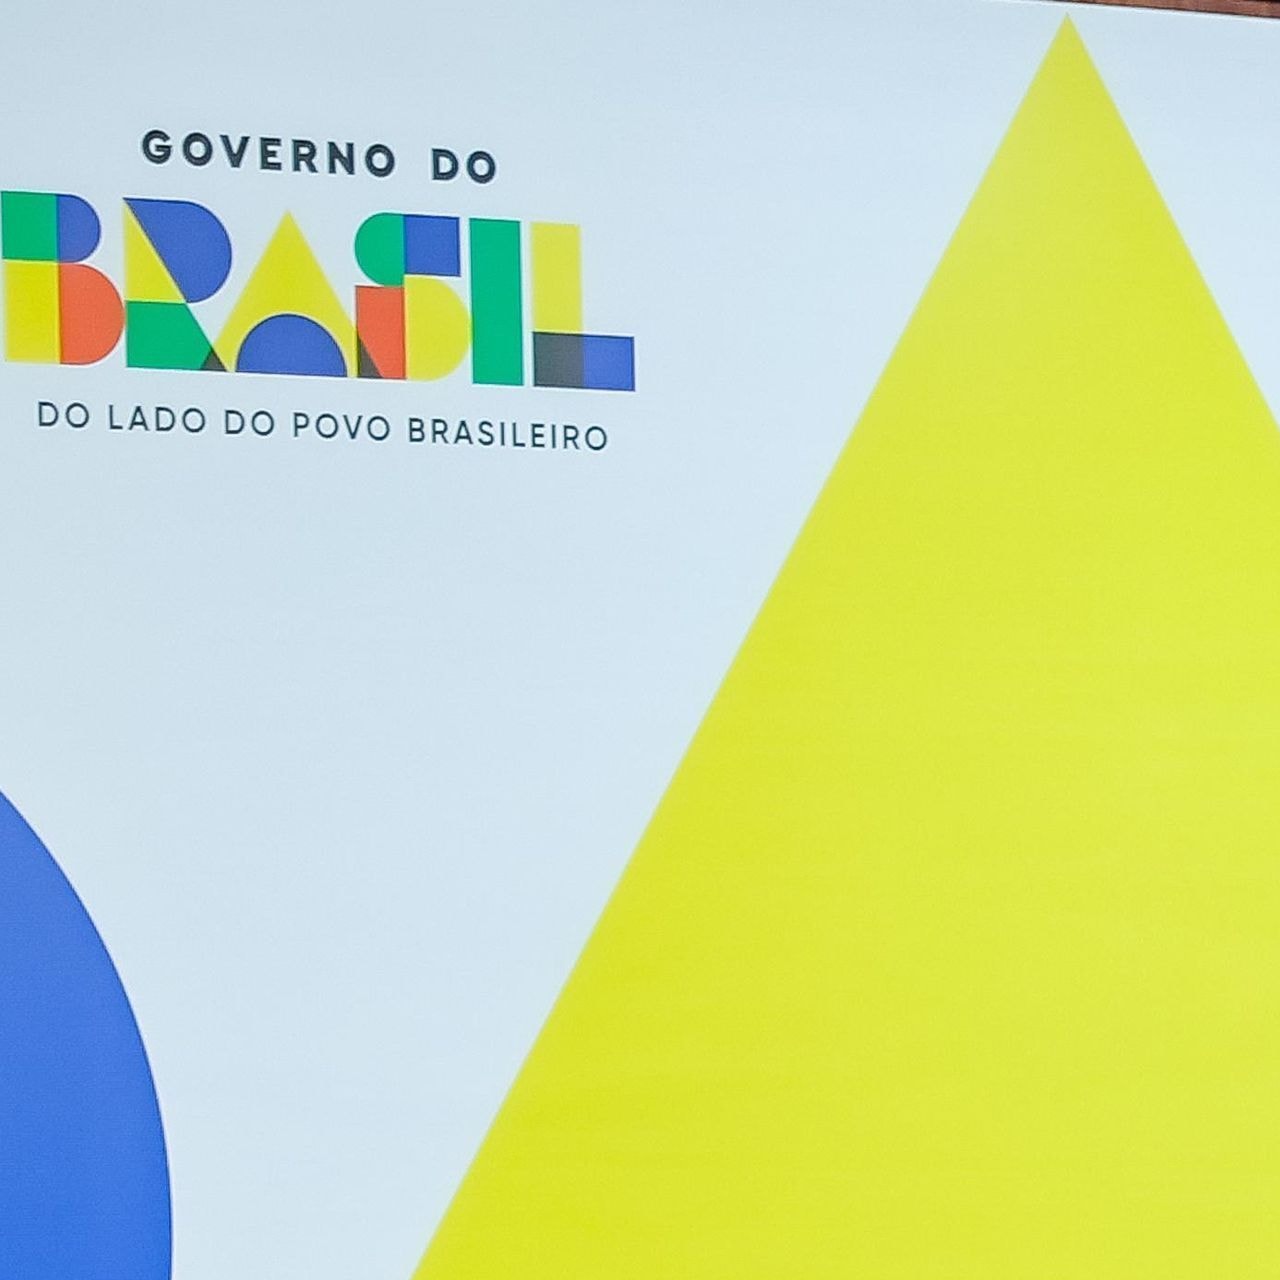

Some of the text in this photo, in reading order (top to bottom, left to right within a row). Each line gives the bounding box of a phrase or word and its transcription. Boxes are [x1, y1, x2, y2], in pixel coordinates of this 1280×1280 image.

[141, 128, 498, 186] GOVERNO DO
[0, 189, 637, 392] BRASIL
[37, 401, 609, 453] DO LADO DO POVO BRASILEIRO
